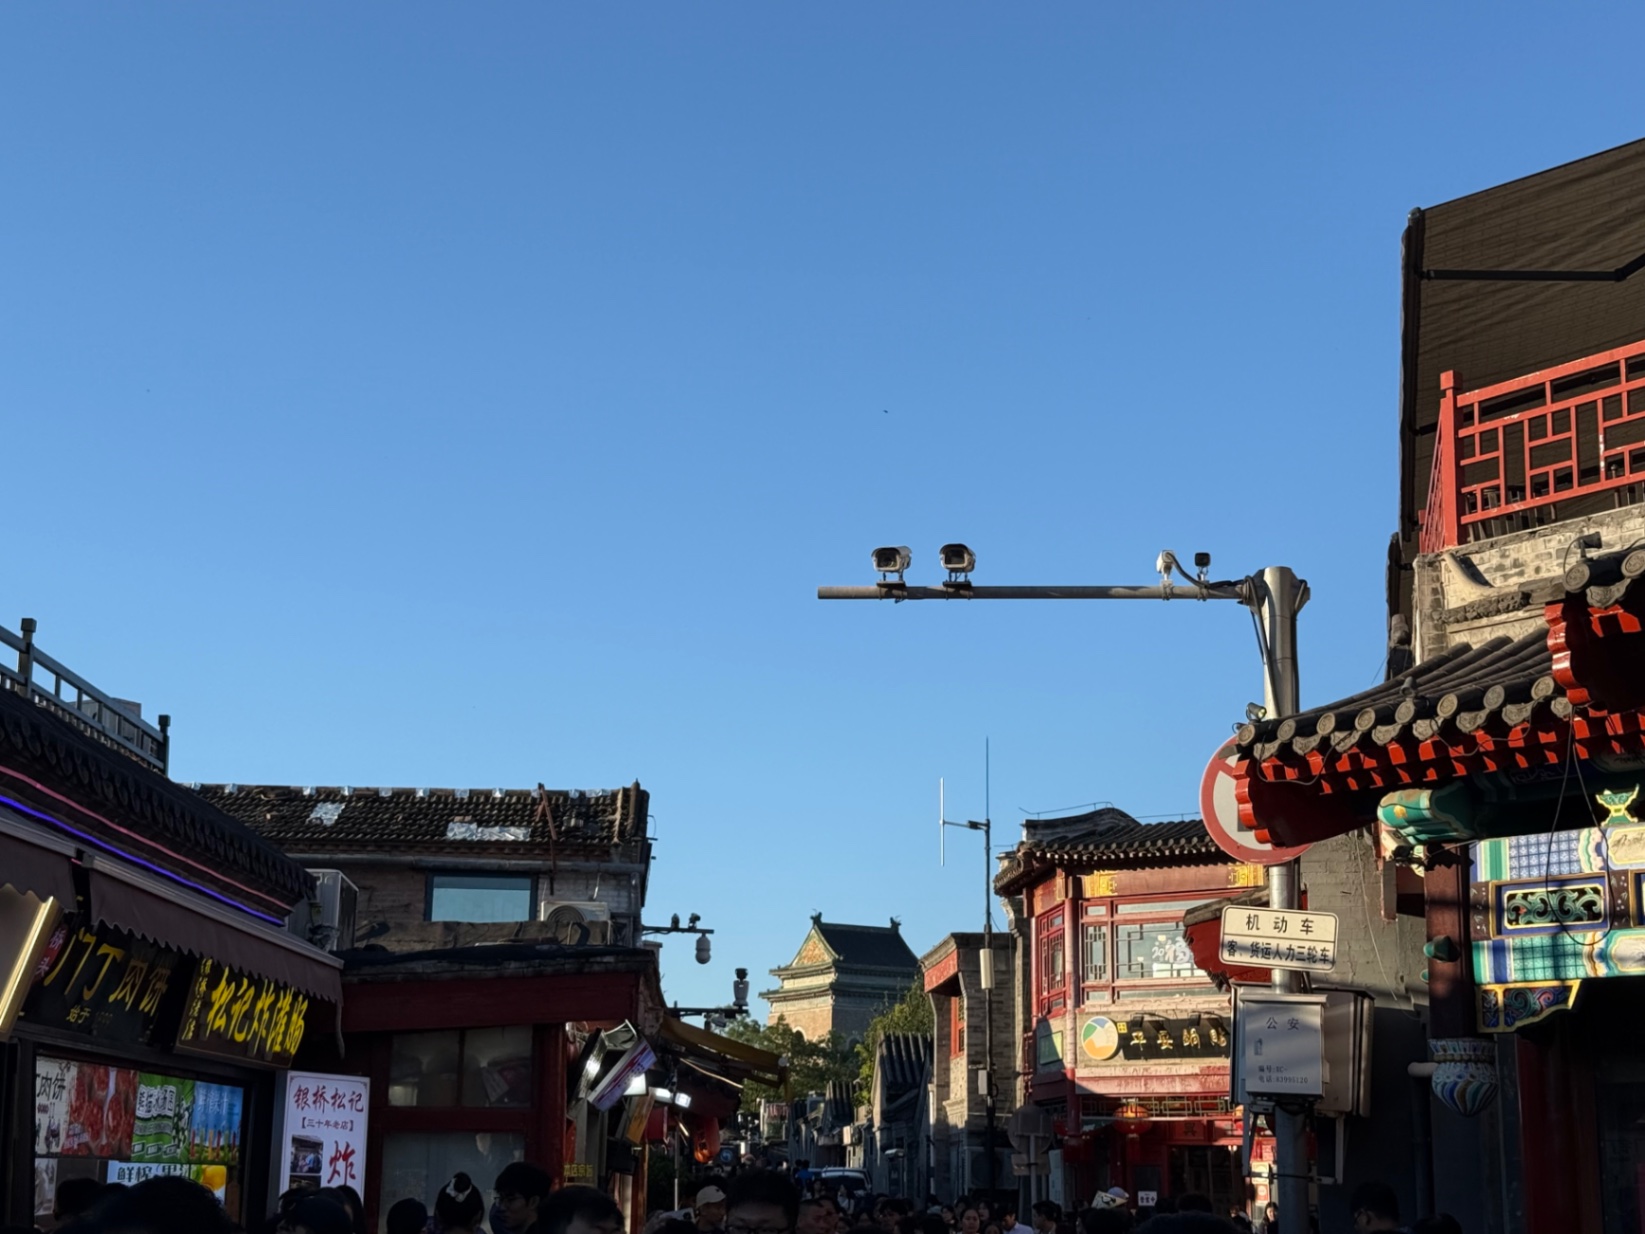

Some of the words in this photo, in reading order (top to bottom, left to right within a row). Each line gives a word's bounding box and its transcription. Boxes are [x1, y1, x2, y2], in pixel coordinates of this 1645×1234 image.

[1246, 913, 1314, 935] 机动车
[1227, 939, 1330, 964] 客、货运人力三轮车
[42, 926, 172, 1017] 门丁肉饼
[206, 965, 309, 1055] 松记炸灌肠
[1266, 1016, 1300, 1031] 公安
[293, 1084, 364, 1114] 银桥松记
[326, 1140, 356, 1186] 炸
